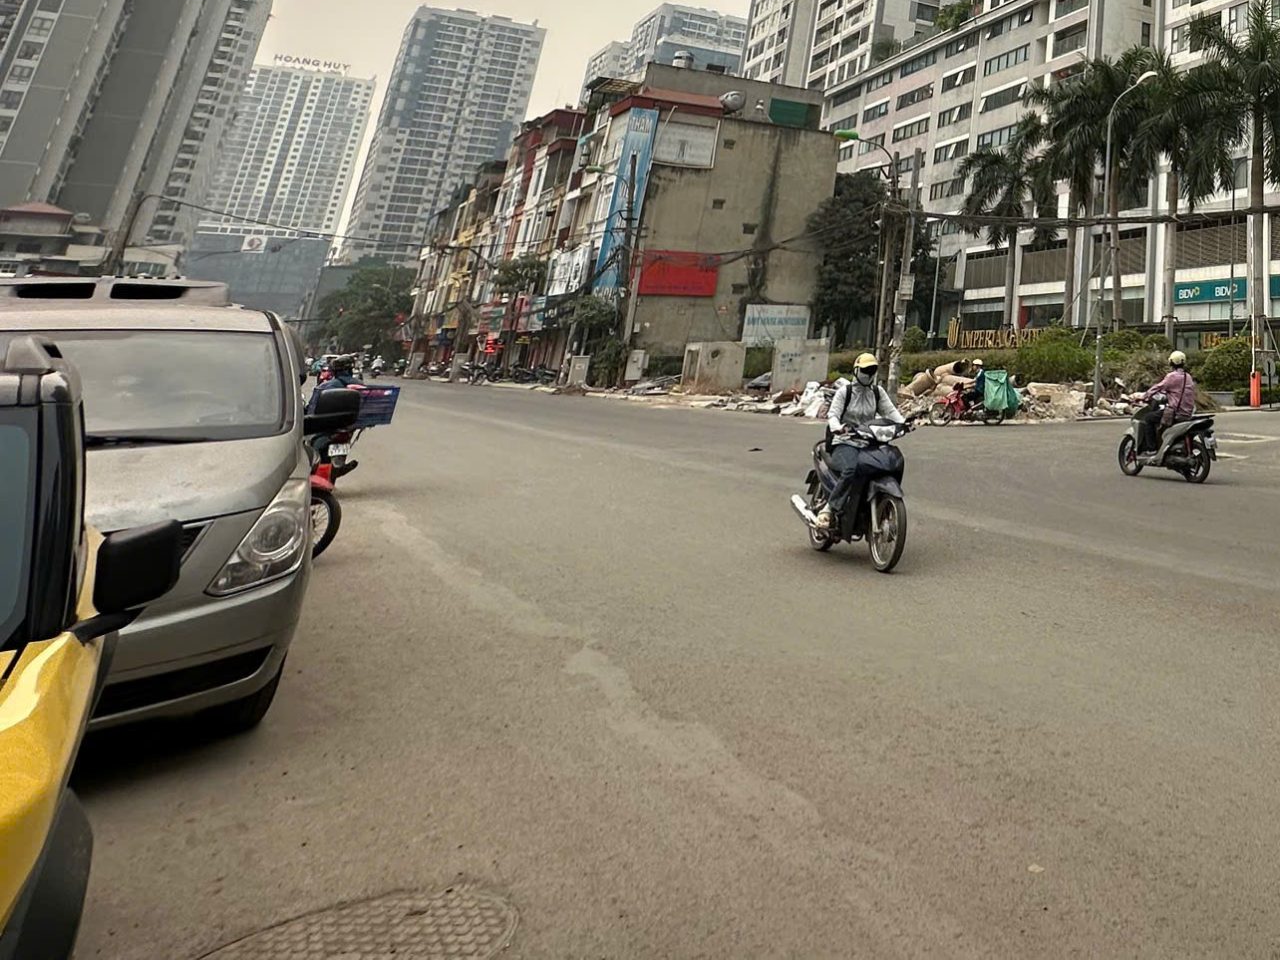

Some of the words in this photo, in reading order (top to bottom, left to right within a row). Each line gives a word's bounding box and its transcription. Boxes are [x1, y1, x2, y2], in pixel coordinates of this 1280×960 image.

[323, 61, 352, 71] HUY
[1179, 289, 1194, 299] BIDV
[1215, 286, 1231, 297] BIDV
